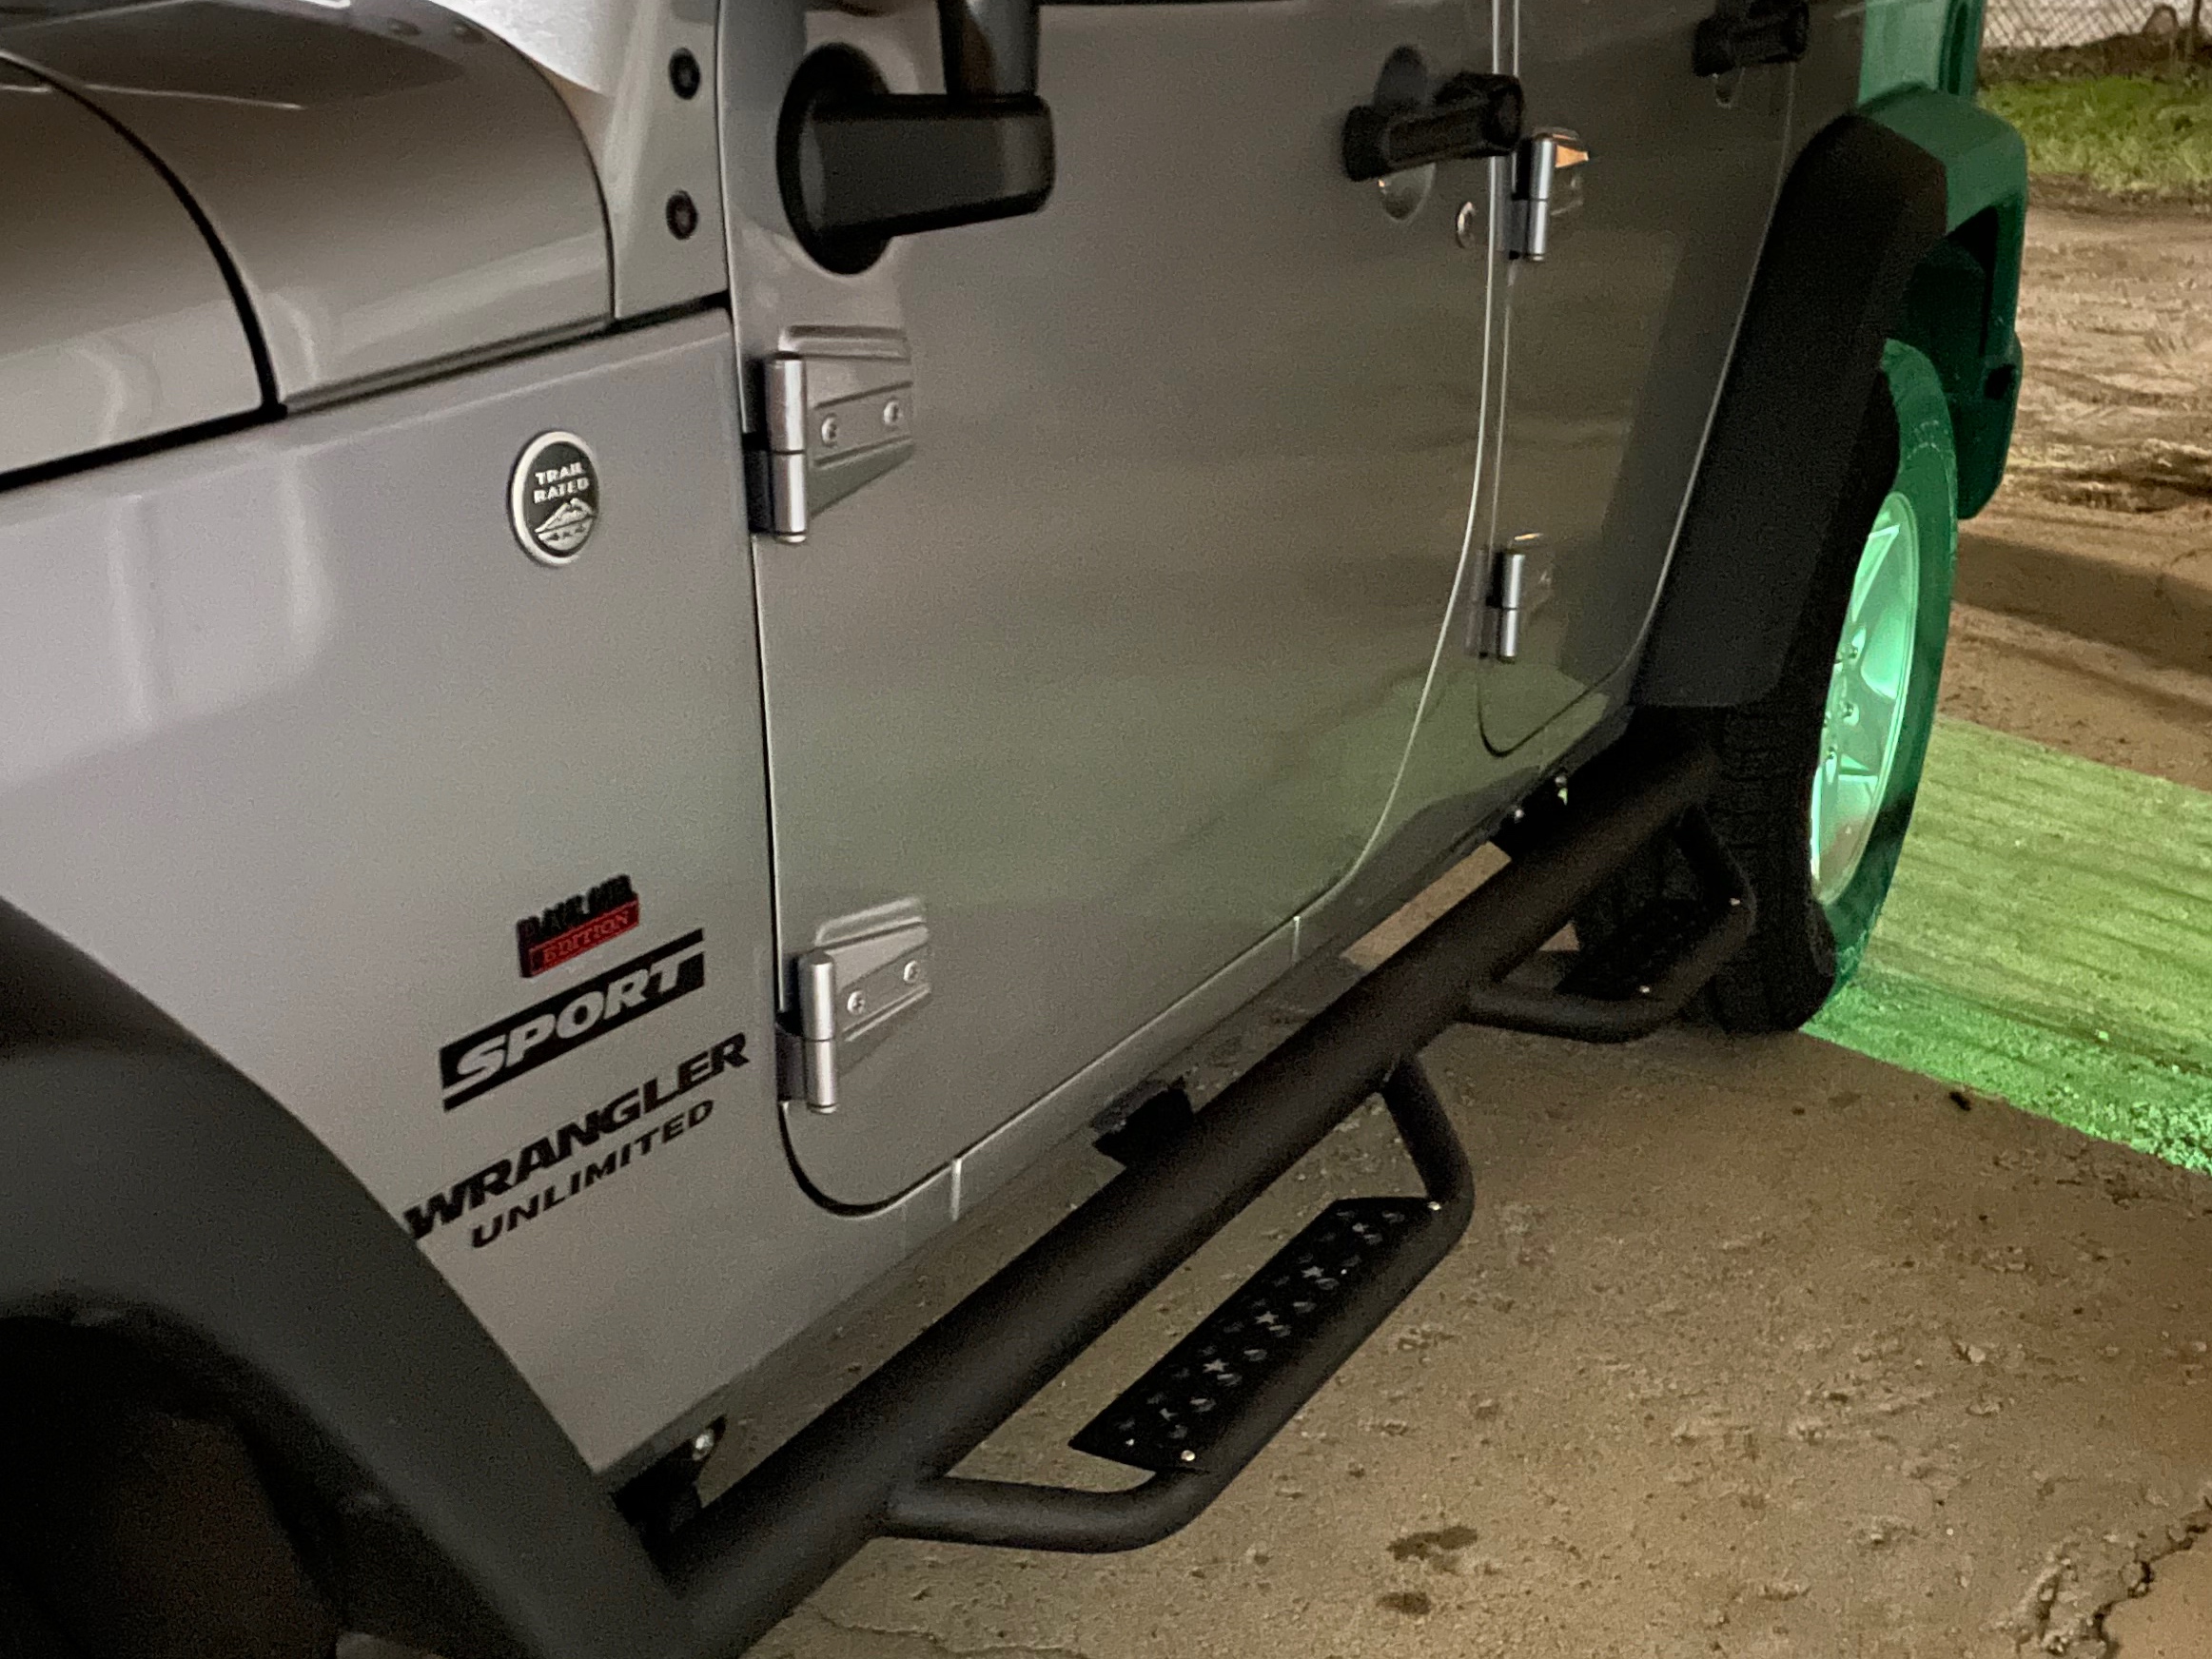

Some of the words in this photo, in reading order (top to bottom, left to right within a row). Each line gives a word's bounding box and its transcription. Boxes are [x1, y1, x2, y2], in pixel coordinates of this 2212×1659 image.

[534, 478, 589, 504] RATED
[535, 462, 584, 485] TRAIL
[543, 910, 629, 962] EDITION
[457, 958, 685, 1084] SPORT
[403, 1032, 751, 1239] WRANGLER
[472, 1100, 714, 1248] UNLIMITED
